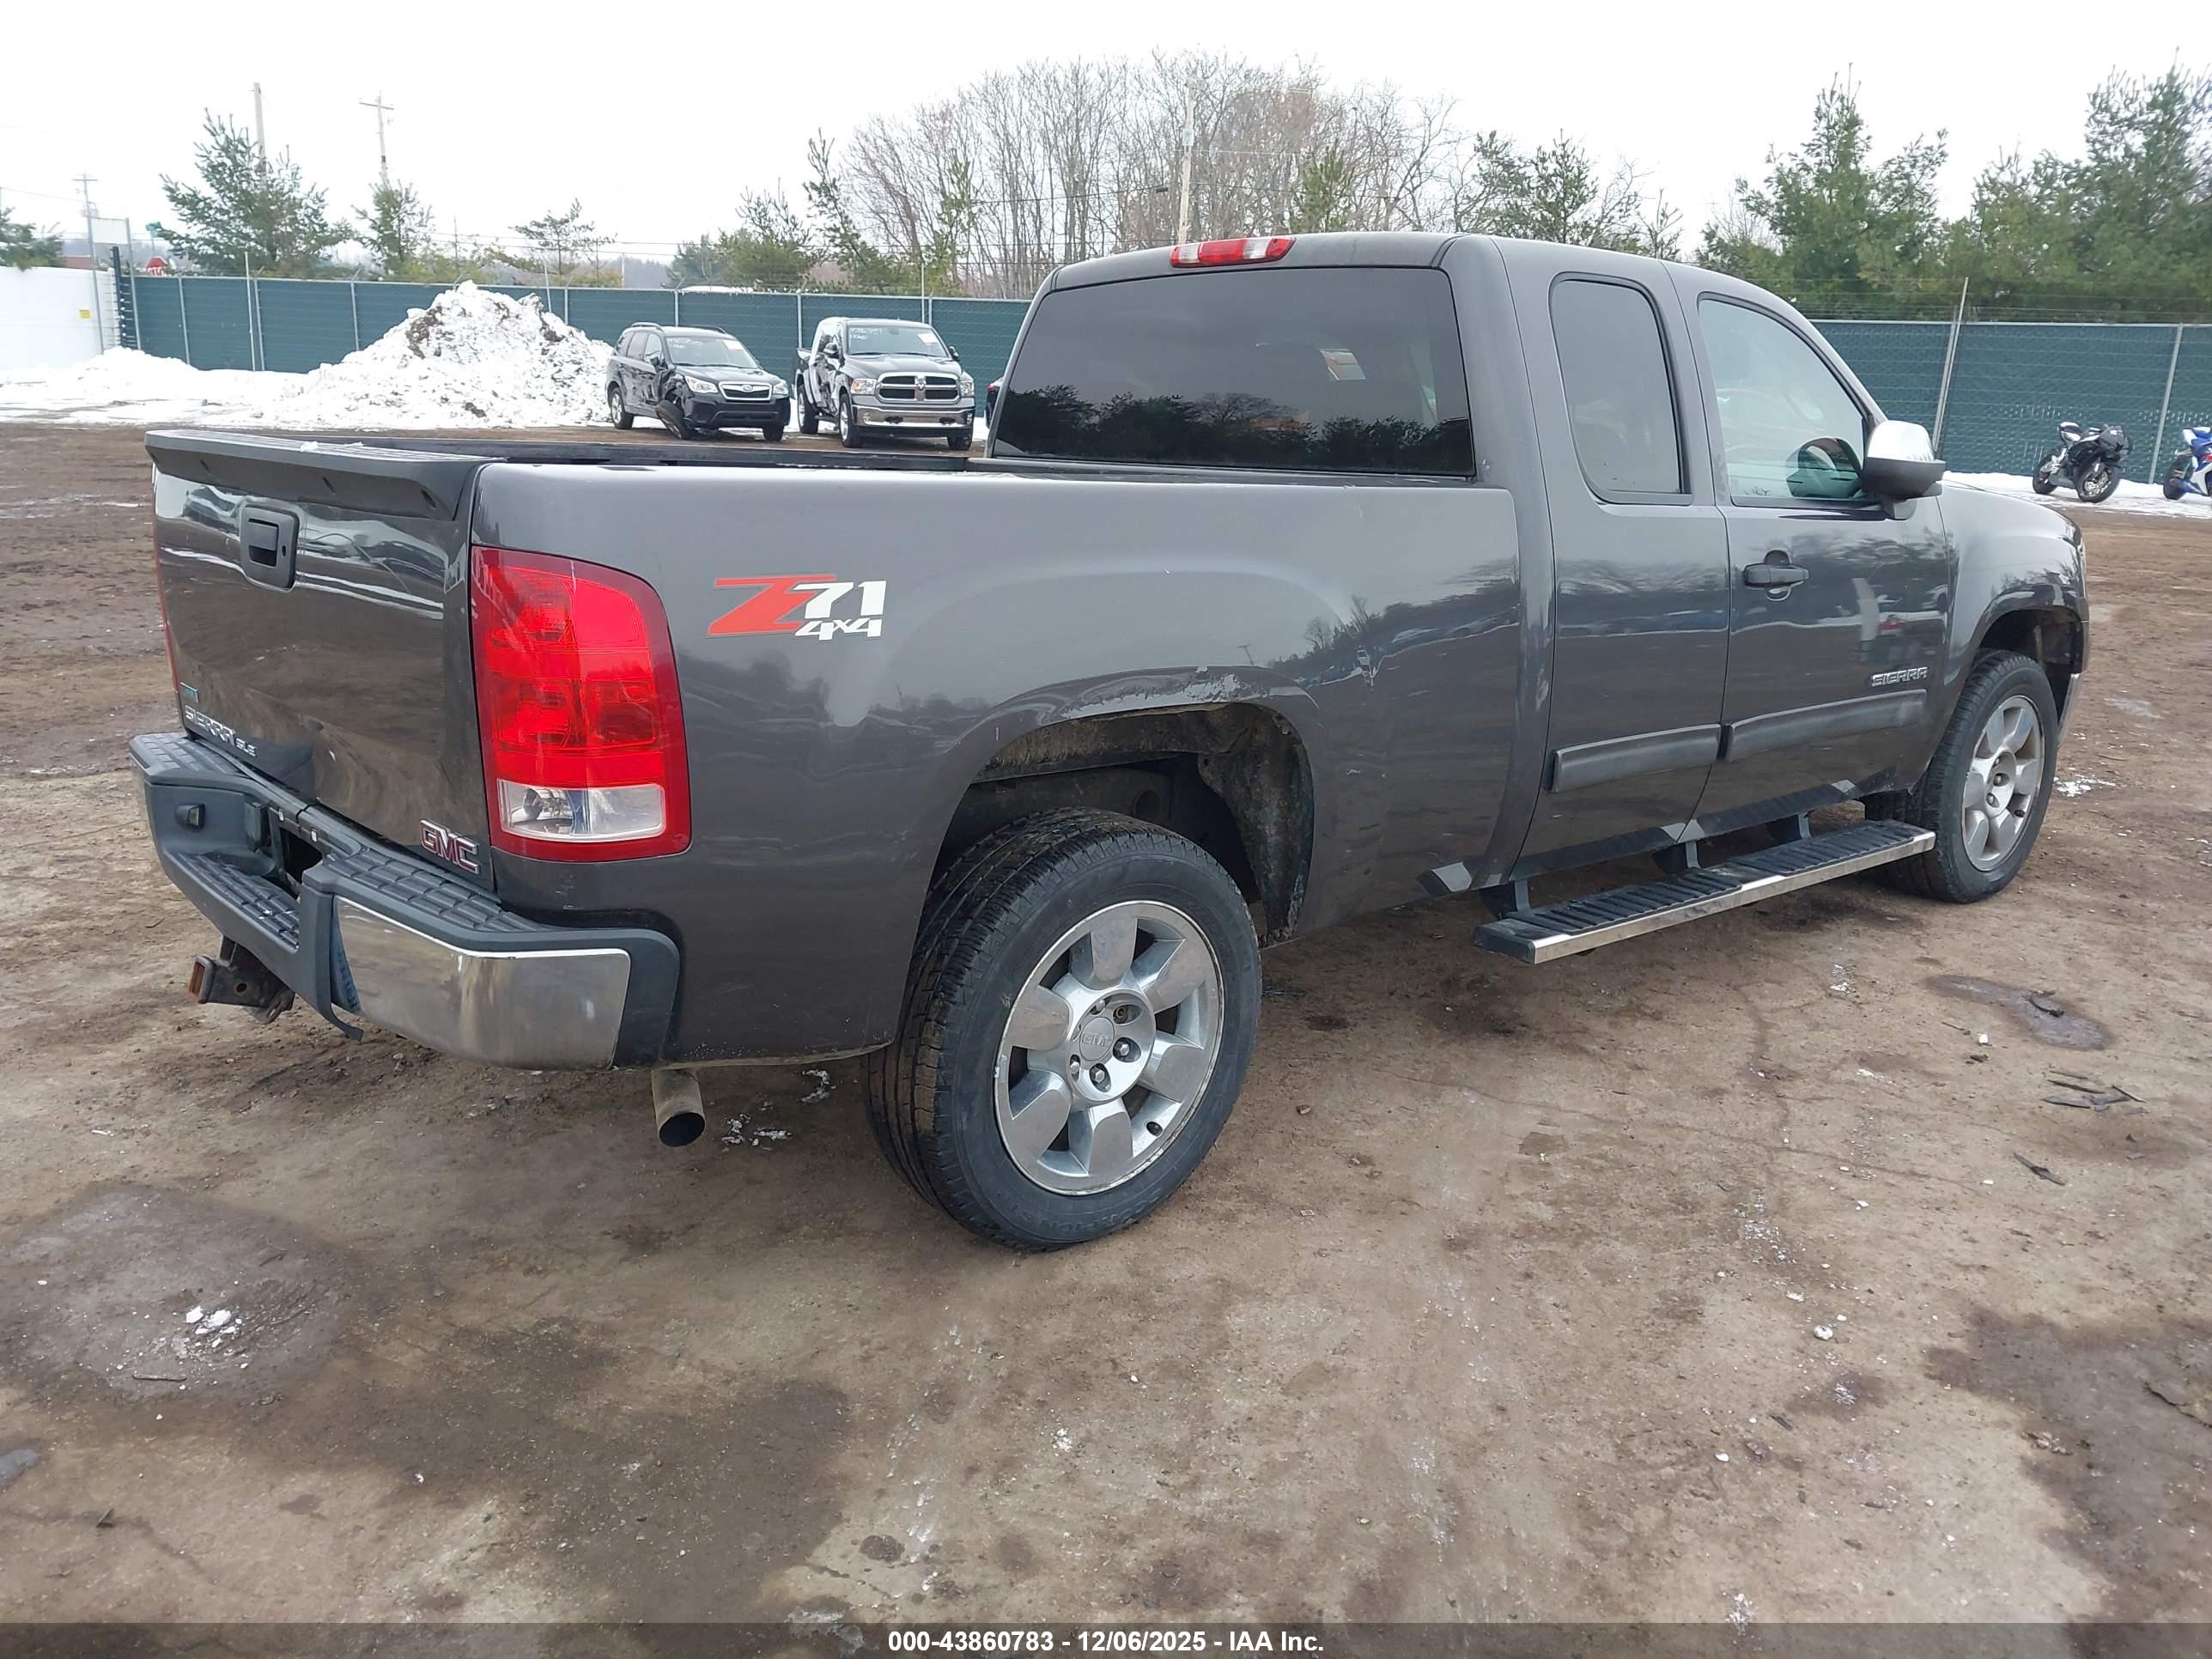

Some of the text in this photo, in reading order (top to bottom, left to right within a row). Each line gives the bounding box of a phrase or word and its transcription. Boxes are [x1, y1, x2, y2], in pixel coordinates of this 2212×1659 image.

[708, 573, 887, 636] Z71
[1871, 666, 1929, 687] SIERRA
[185, 705, 236, 745] SIERRA
[419, 818, 481, 874] GMC
[1082, 1033, 1114, 1047] GMC
